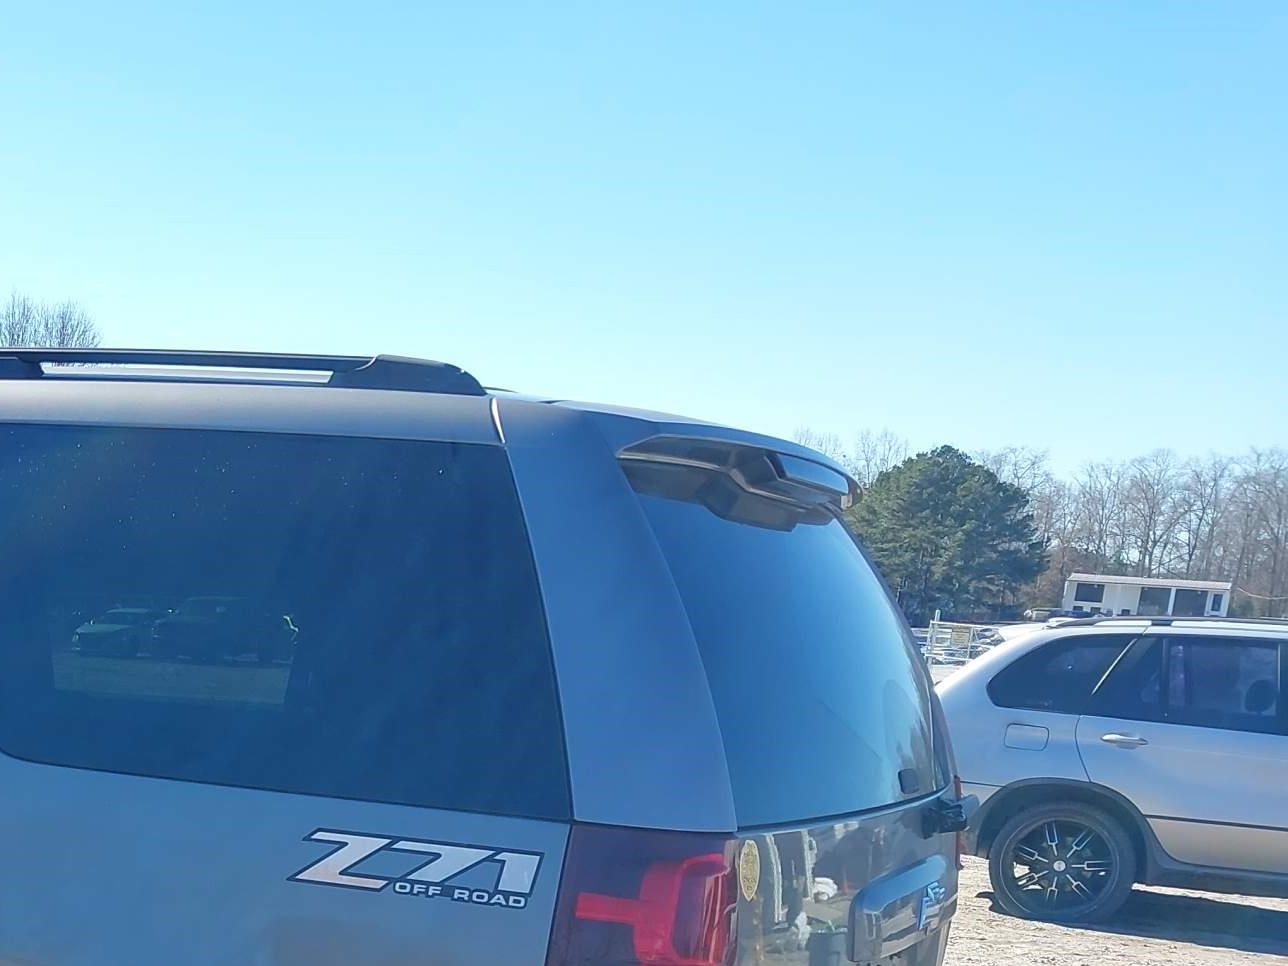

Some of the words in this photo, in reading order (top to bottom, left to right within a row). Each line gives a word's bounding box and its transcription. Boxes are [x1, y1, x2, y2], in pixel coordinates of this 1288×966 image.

[289, 829, 543, 895] Z71
[393, 881, 442, 898] OFF
[453, 887, 527, 908] ROAD
